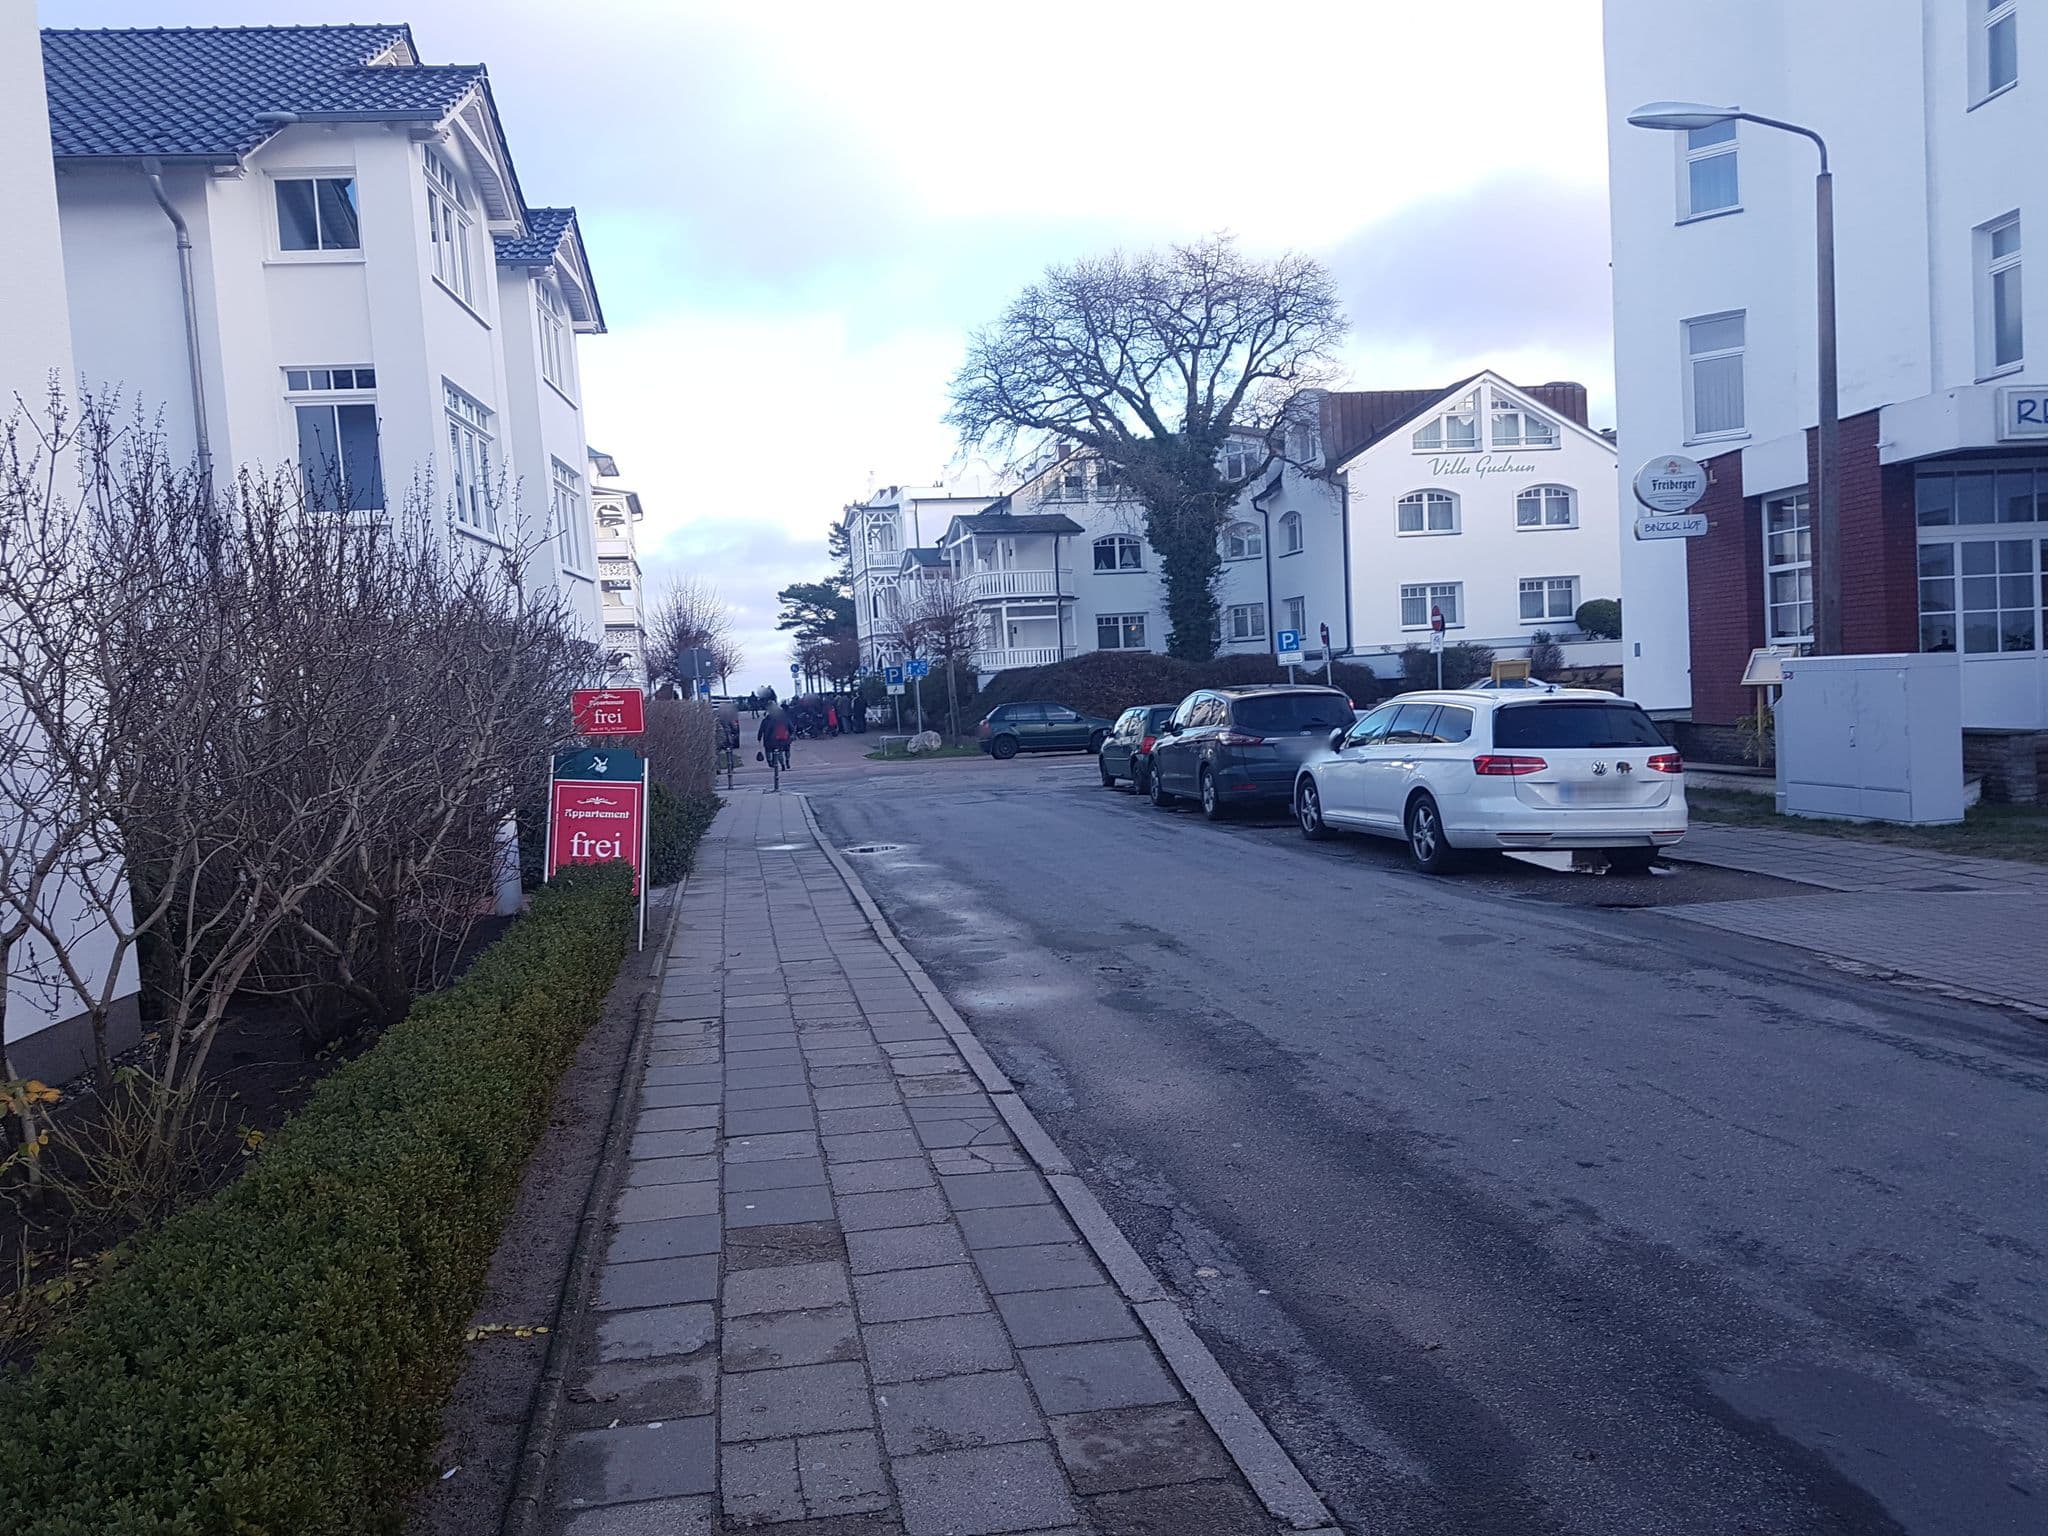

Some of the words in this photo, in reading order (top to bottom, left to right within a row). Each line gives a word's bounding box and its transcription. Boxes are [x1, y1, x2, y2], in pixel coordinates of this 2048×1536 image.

[1427, 456, 1471, 476] Villa
[1475, 455, 1537, 479] Gudrun
[1651, 479, 1697, 491] Freiberger
[1682, 519, 1703, 531] HOF
[1282, 633, 1294, 649] P
[889, 669, 899, 682] P
[594, 708, 622, 724] frei
[563, 808, 630, 819] Appartement
[570, 831, 621, 858] frei
